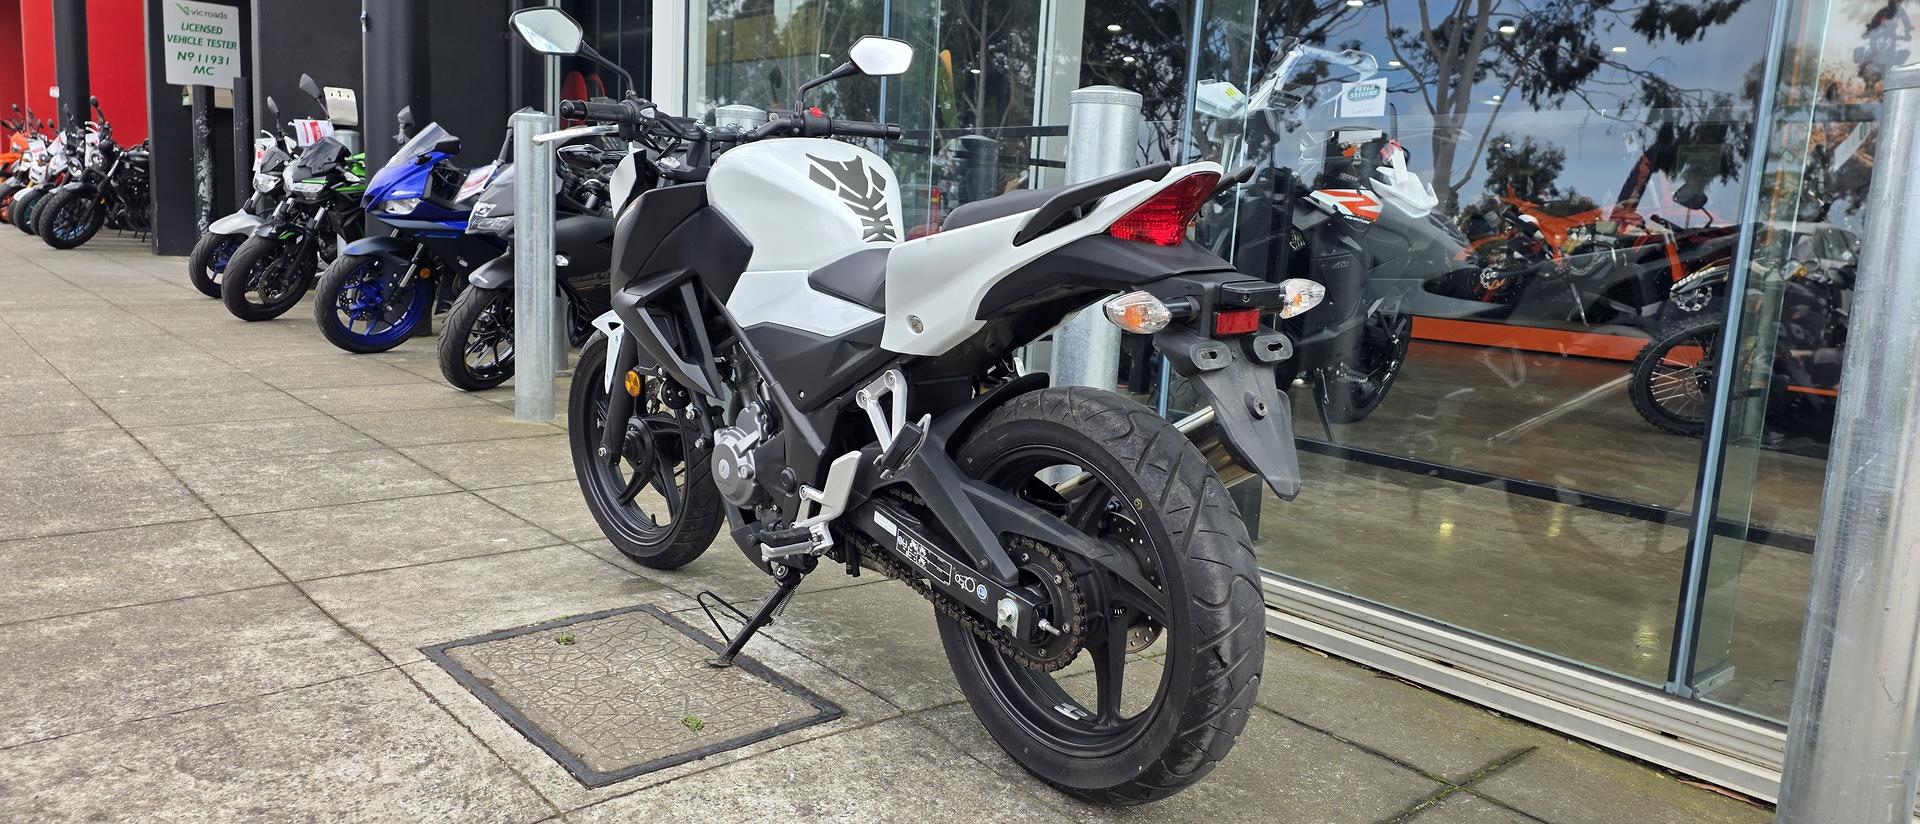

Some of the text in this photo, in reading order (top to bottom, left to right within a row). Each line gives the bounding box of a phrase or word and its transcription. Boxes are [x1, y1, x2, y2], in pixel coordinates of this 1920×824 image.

[181, 22, 223, 35] LICENSED
[167, 34, 237, 50] VEHICLE TESTER
[193, 65, 215, 76] MC
